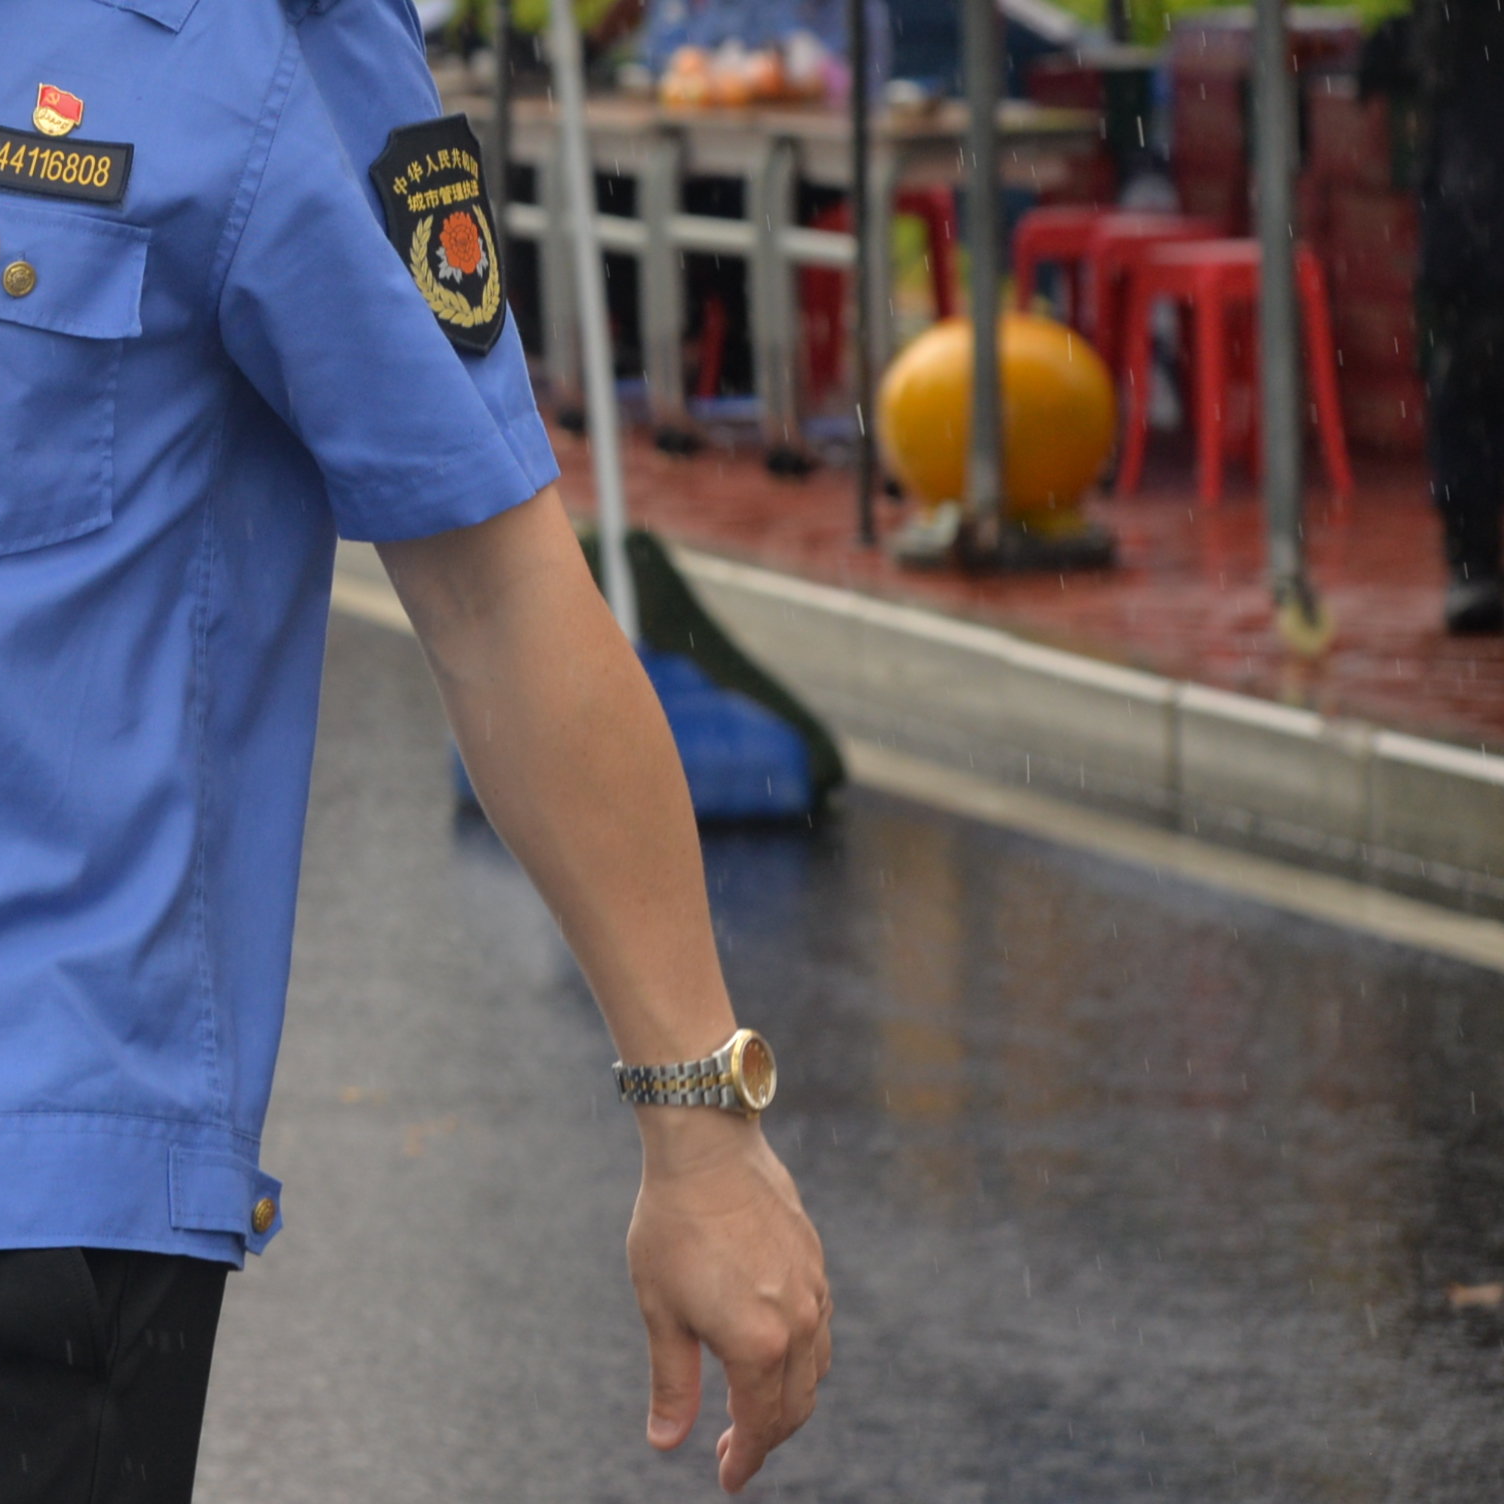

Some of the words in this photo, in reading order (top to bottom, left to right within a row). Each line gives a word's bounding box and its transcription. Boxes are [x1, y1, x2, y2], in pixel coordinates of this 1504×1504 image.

[393, 147, 479, 195] 中华人民共和国
[407, 179, 480, 213] 城市管理执法
